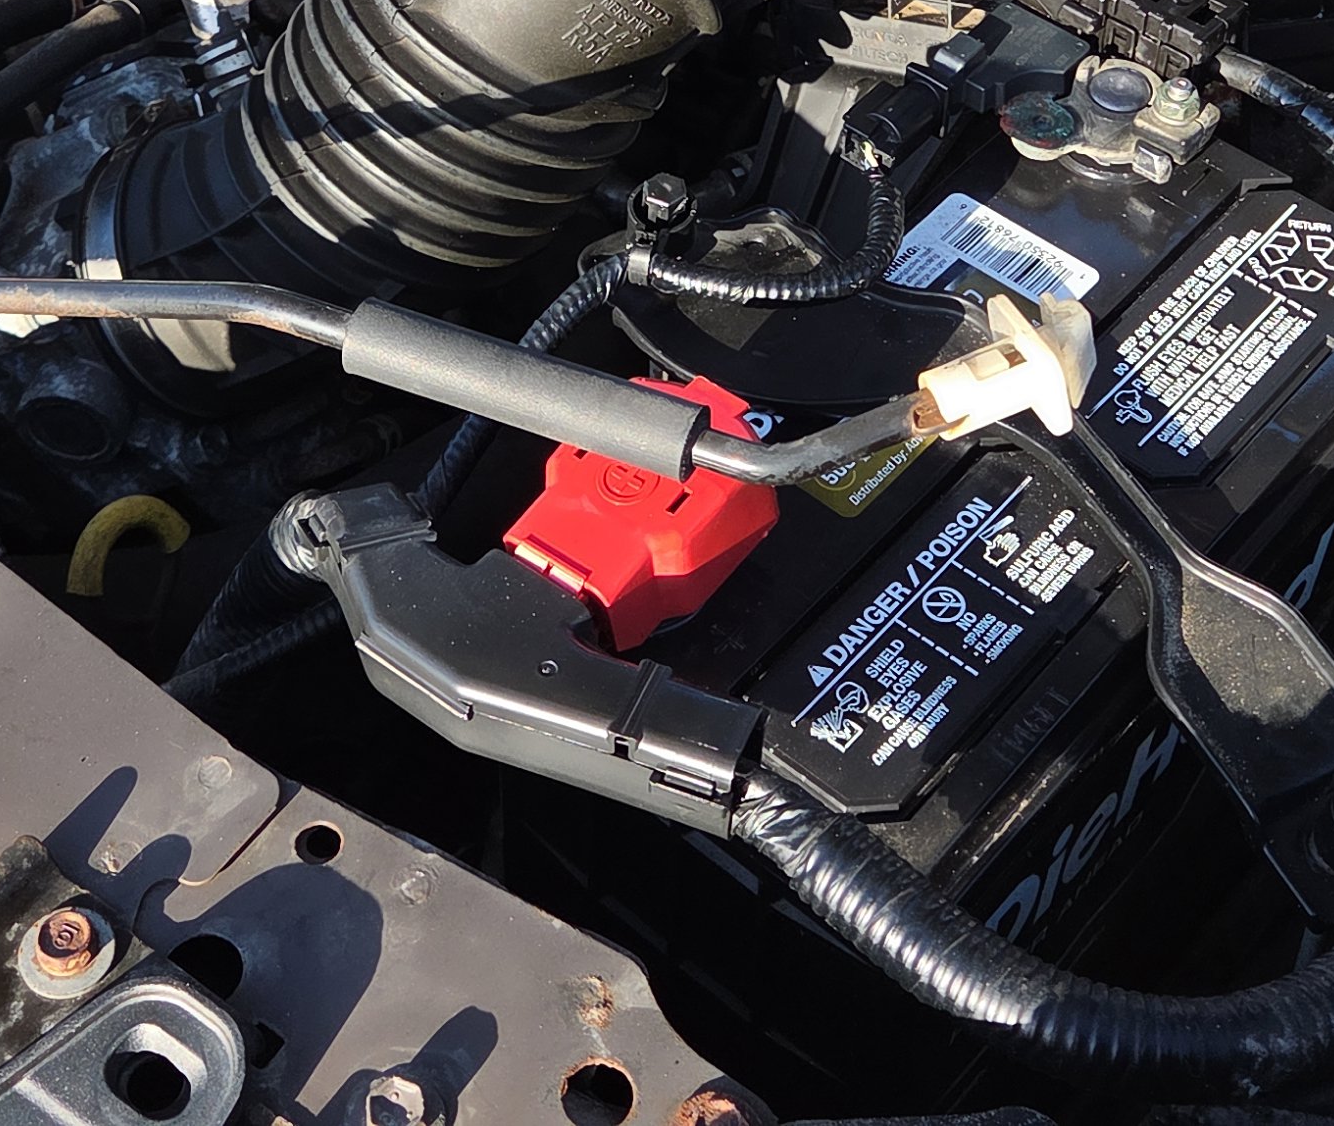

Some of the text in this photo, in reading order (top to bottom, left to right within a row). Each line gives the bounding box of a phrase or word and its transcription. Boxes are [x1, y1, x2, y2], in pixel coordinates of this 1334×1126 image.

[978, 215, 1021, 243] 76812
[1288, 219, 1331, 233] RETURN
[1021, 239, 1064, 268] 92350
[1131, 286, 1235, 391] FLUSH EYES IMMEDIATELY
[1113, 363, 1129, 376] DO
[1124, 347, 1144, 365] NOT
[1144, 373, 1174, 398] WITH
[1196, 325, 1219, 346] GET
[1158, 323, 1241, 408] MEDICAL HELP FAST
[848, 460, 897, 506] Distributed
[891, 448, 909, 468] by:
[1005, 509, 1075, 582] SULFURIC ACID
[1018, 542, 1063, 588] CAN CAUSE
[822, 581, 912, 667] DANGER
[915, 497, 993, 571] POISON
[1028, 552, 1070, 596] BLINDNESS
[1040, 546, 1095, 604] SEVERE BURNS
[955, 611, 978, 632] NO
[865, 639, 905, 679] SHIELD
[877, 656, 910, 689] EYES
[867, 660, 928, 723] EXPLOSIVE
[881, 689, 921, 730] GASES
[871, 675, 958, 766] CAN CAUSE BLINDNESS
[917, 702, 950, 735] INJURY
